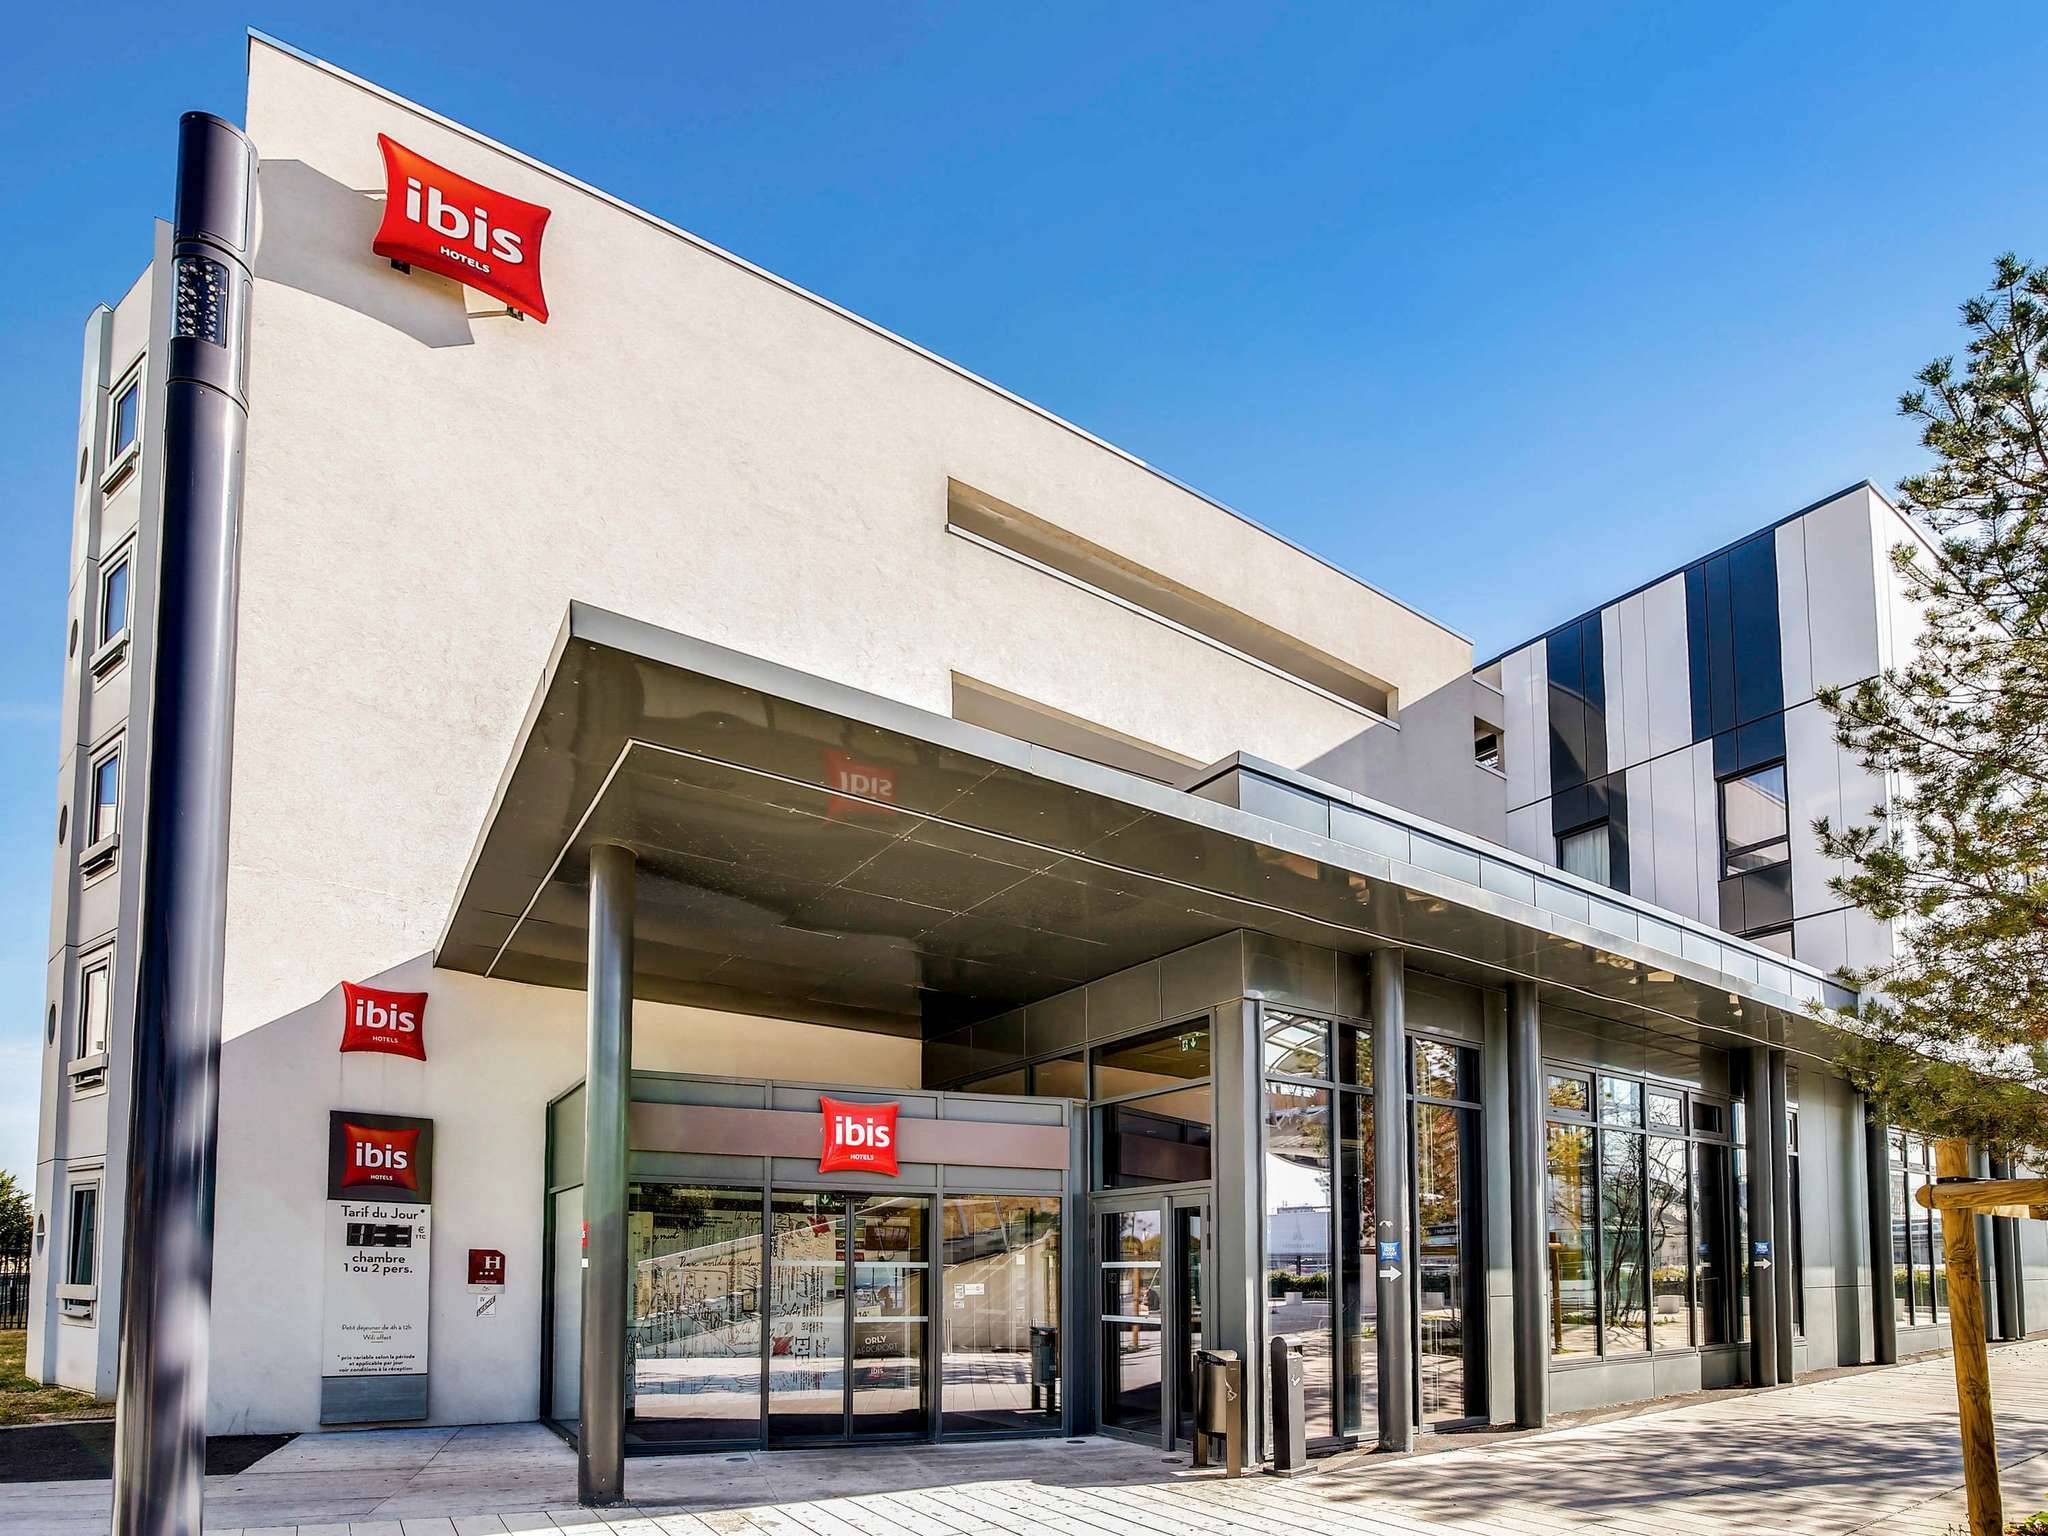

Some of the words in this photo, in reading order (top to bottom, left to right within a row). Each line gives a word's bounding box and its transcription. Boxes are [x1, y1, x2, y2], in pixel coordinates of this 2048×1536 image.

[406, 177, 523, 264] ibis
[440, 245, 490, 273] HOTELS
[356, 999, 415, 1032] ibis
[835, 1115, 890, 1148] ibis
[356, 1142, 408, 1169] ibis
[341, 1205, 370, 1218] Tarif
[372, 1207, 387, 1219] du
[418, 1226, 425, 1234] €
[352, 1250, 406, 1264] chambre
[483, 1256, 501, 1269] H
[343, 1263, 349, 1273] 1
[353, 1265, 368, 1273] ou
[371, 1264, 380, 1273] 2
[383, 1266, 413, 1276] pers.
[864, 1335, 887, 1345] ORLY
